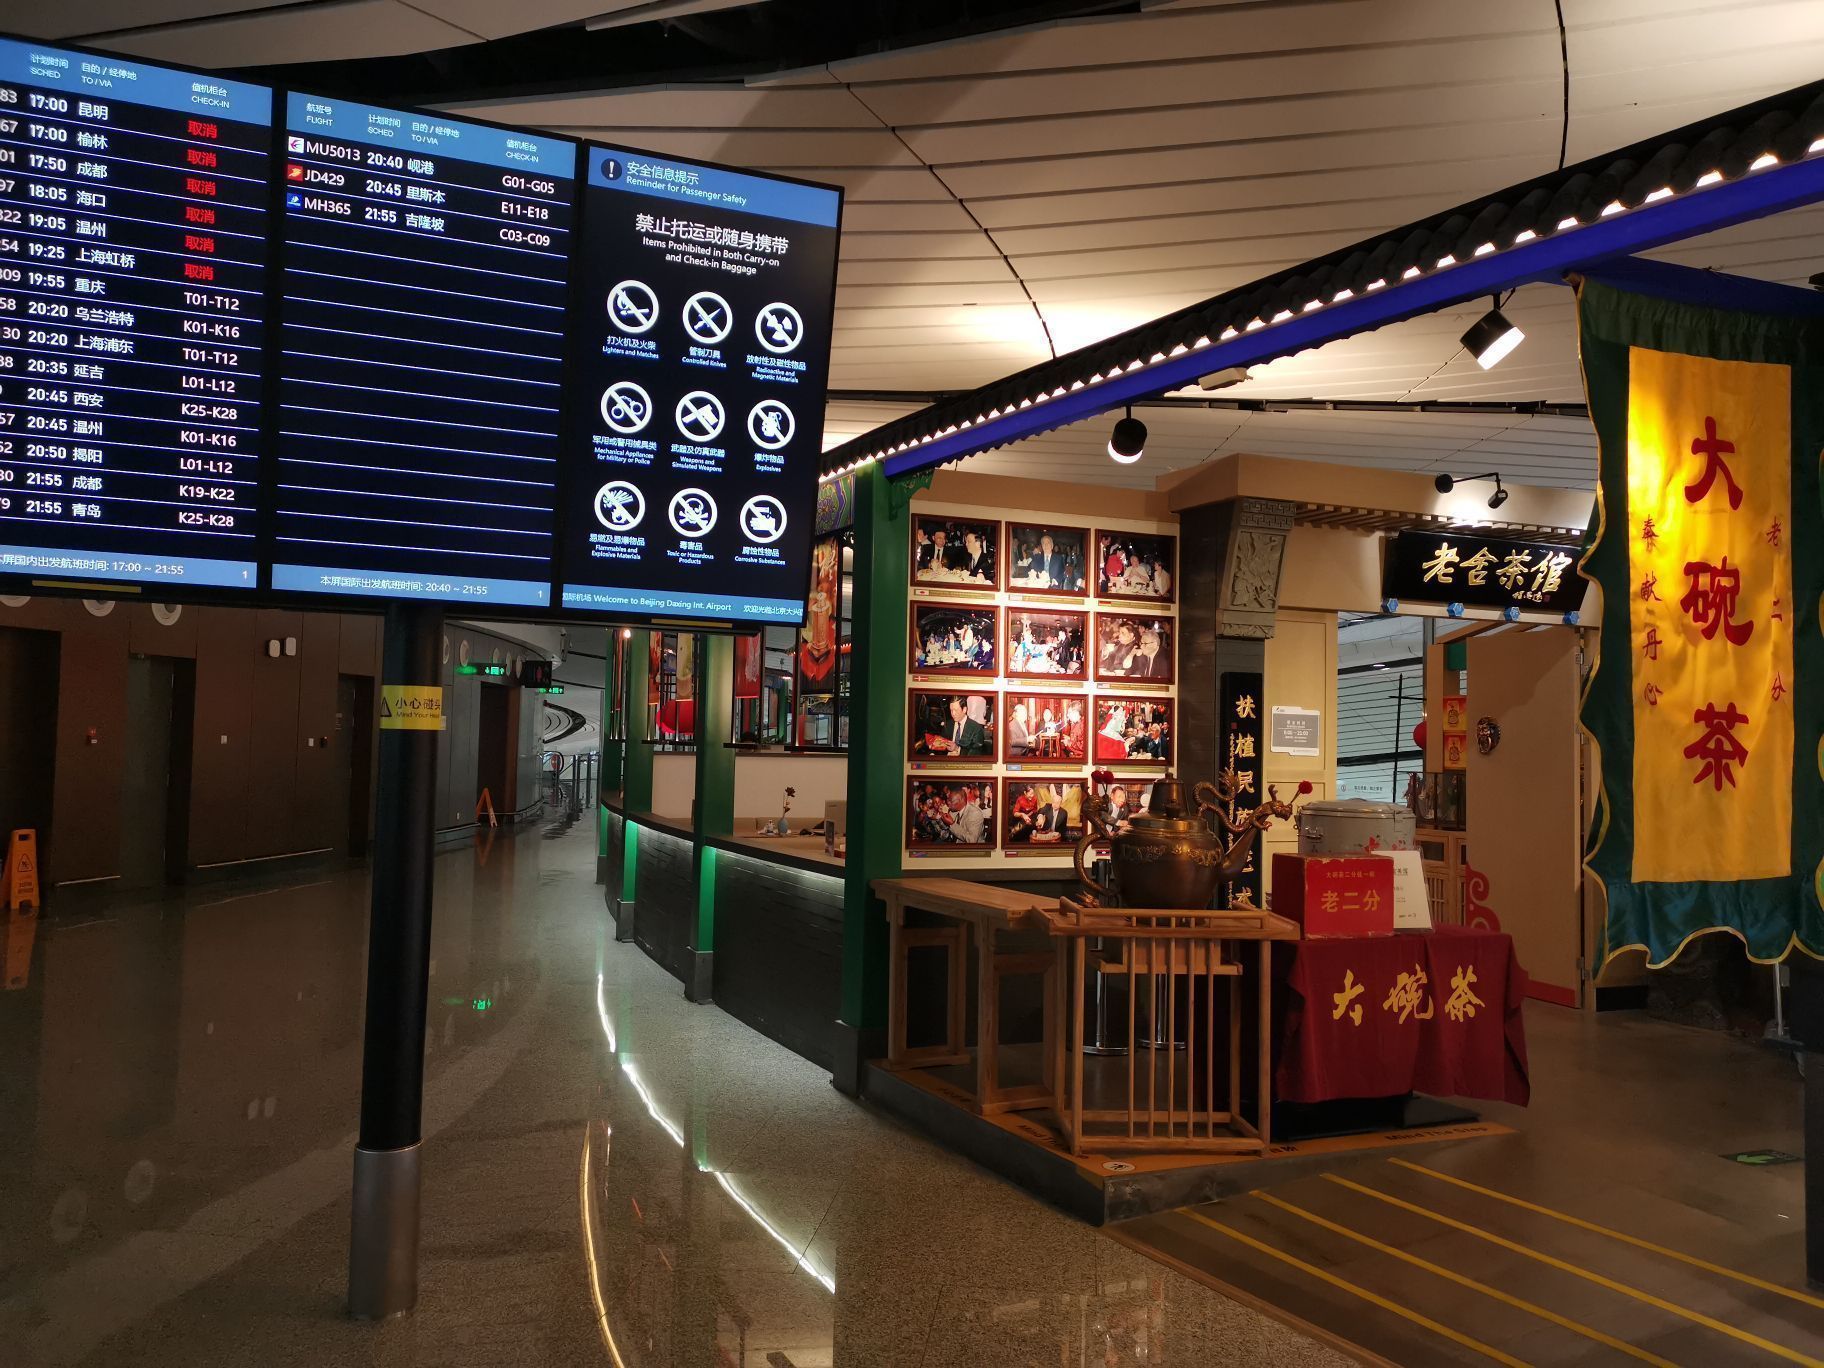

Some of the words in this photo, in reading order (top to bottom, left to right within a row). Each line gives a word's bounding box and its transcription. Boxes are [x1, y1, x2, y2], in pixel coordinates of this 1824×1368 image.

[31, 53, 68, 69] 计划时间
[192, 83, 227, 96] 值机柜台
[31, 68, 60, 79] SCHED
[192, 96, 229, 108] CHECK-IN
[30, 94, 68, 112] 17:00
[78, 103, 108, 120] 昆明
[188, 121, 218, 138] 取消
[306, 103, 332, 114] 航班号
[368, 115, 400, 128] 计划时间
[506, 139, 537, 153] 值机柜台
[30, 124, 67, 142] 17:00
[78, 132, 108, 149] 榆林
[188, 150, 216, 167] 取消
[306, 116, 333, 126] FLIGHT
[368, 127, 393, 137] SCHED
[506, 151, 539, 163] CHECK-IN
[30, 154, 66, 172] 17:50
[77, 162, 107, 178] 成都
[187, 179, 215, 196] 取消
[306, 141, 360, 161] MU5013
[367, 152, 402, 169] 20:40
[407, 159, 434, 175] 岘港
[502, 175, 554, 194] G01-G05
[626, 161, 699, 184] 安全信息提示
[29, 184, 67, 200] 18:05
[77, 191, 106, 207] 海口
[186, 207, 214, 224] 取消
[305, 169, 344, 186] JD429
[366, 180, 401, 196] 20:45
[406, 187, 445, 204] 里斯本
[502, 202, 548, 219] E11-E18
[626, 176, 665, 190] Reminder
[668, 184, 679, 192] for
[682, 186, 720, 201] Passenger
[723, 192, 746, 206] Safety
[28, 214, 66, 230] 19:05
[76, 220, 106, 237] 温州
[185, 236, 214, 252] 取消
[305, 198, 351, 215] MH365
[365, 208, 396, 223] 21:55
[406, 214, 444, 232] 吉隆坡
[500, 229, 550, 247] C03-C09
[636, 213, 789, 255] 禁止托运或随身携带
[28, 243, 65, 259] 19:25
[76, 249, 135, 268] 上海虹桥
[185, 264, 214, 280] 取消
[643, 237, 666, 248] Items
[668, 241, 711, 256] Prohibited
[713, 248, 721, 256] in
[723, 249, 742, 261] Both
[744, 253, 779, 267] Carry-on
[666, 252, 681, 262] and
[684, 255, 719, 269] Check-in
[721, 261, 757, 275] Baggage
[28, 273, 64, 288] 19:55
[75, 278, 106, 294] 重庆
[184, 293, 240, 310] T01-T12
[28, 302, 68, 318] 20:20
[75, 308, 134, 326] 乌兰浩特
[184, 321, 240, 338] K01-K16
[28, 331, 67, 345] 20:20
[74, 335, 134, 354] 上海浦东
[183, 349, 238, 366] T01-T12
[607, 336, 656, 350] 打火机及火柴
[689, 346, 720, 359] 管制刀具
[28, 359, 67, 374] 20:35
[74, 364, 104, 379] 延吉
[182, 376, 235, 393] L01-L12
[28, 388, 67, 402] 20:45
[74, 393, 103, 407] 西安
[182, 404, 237, 420] K25-K28
[27, 416, 67, 431] 20:45
[73, 421, 103, 436] 温州
[181, 431, 237, 447] K01-K16
[27, 445, 66, 459] 20:50
[73, 449, 102, 463] 揭阳
[180, 458, 233, 474] L01-L12
[26, 473, 62, 486] 21:55
[72, 476, 102, 491] 成都
[179, 486, 234, 500] K19-K22
[26, 501, 61, 515] 21:55
[72, 503, 101, 518] 青岛
[179, 512, 234, 526] K25-K28
[112, 562, 140, 572] 17:00
[156, 565, 183, 575] 21:55
[1422, 542, 1573, 593] 老舍茶馆
[426, 582, 451, 593] 20:40
[462, 584, 488, 596] 21:55
[538, 590, 543, 599] 1
[594, 594, 629, 605] Welcome
[630, 596, 638, 605] to
[640, 596, 665, 608] Beijing
[666, 599, 691, 610] Daxing
[693, 601, 705, 610] Int.
[706, 602, 731, 612] Airport
[1680, 415, 1754, 792] 大碗茶
[1765, 516, 1787, 702] 老二分
[1321, 890, 1381, 912] 老二分
[1332, 963, 1486, 1027] 大碗茶
